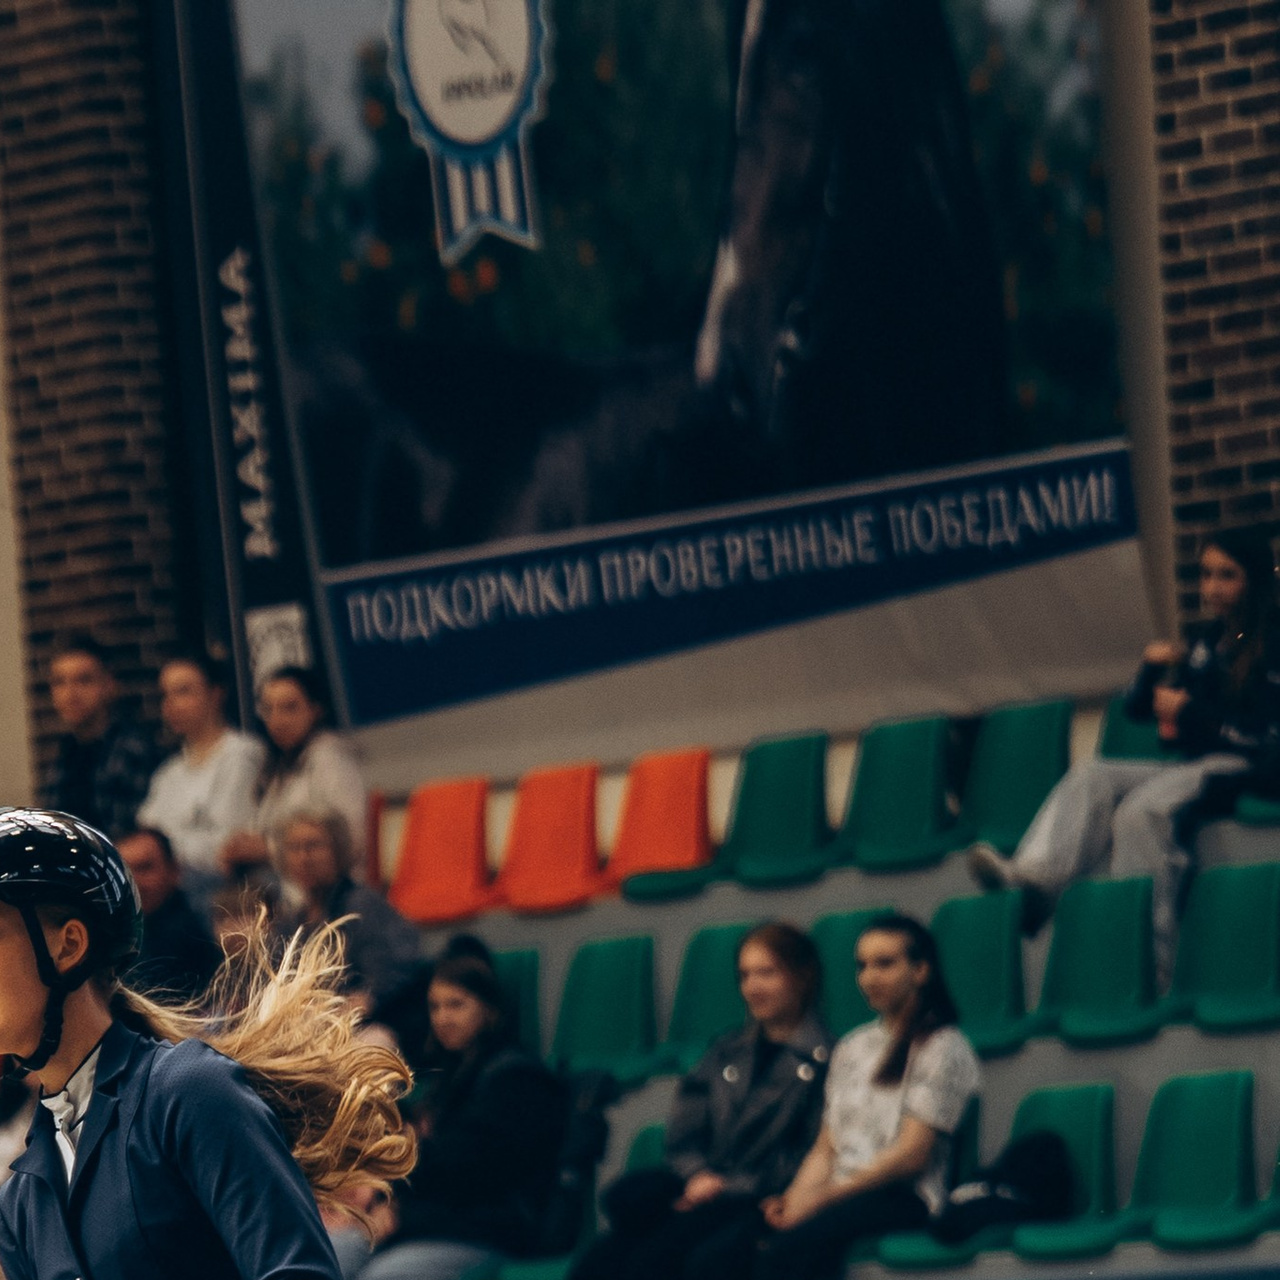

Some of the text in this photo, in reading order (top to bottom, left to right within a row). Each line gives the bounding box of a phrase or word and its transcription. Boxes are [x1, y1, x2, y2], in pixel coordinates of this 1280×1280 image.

[220, 246, 279, 559] MAXIMA
[347, 468, 1116, 643] ПОДКОРМКИ ПРОВЕРЕННЫЕ ПОБЕДАМИ!
